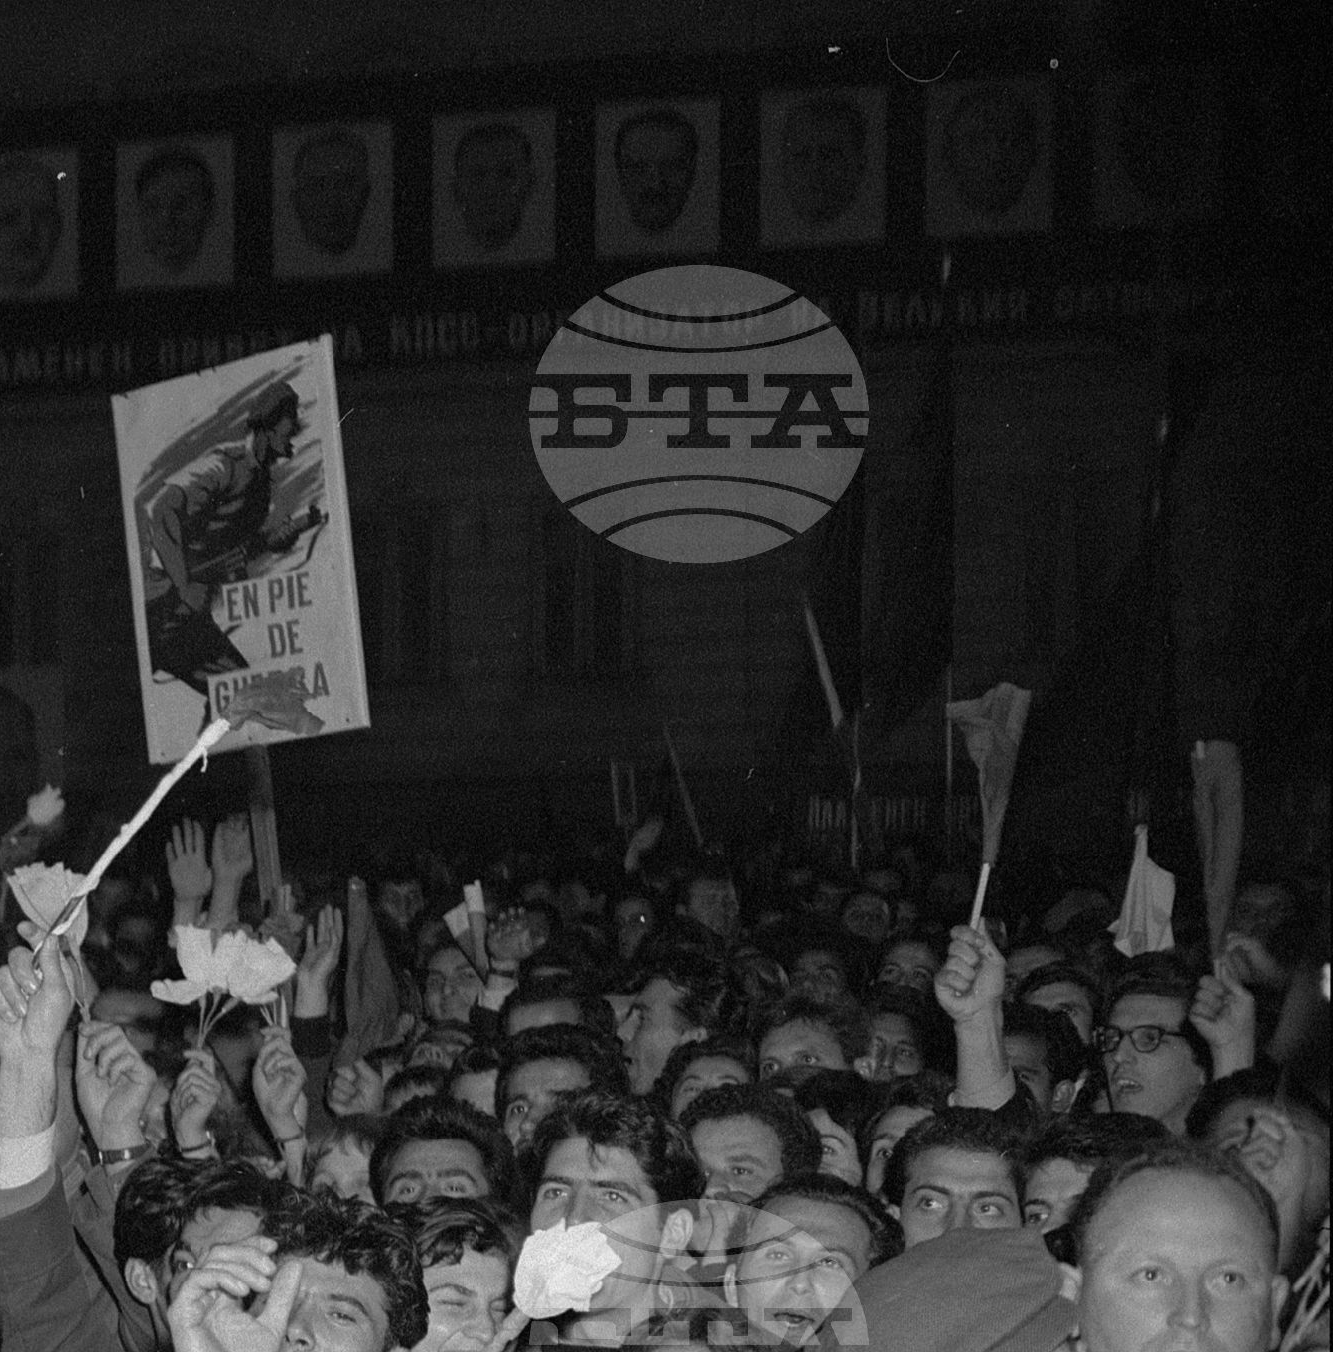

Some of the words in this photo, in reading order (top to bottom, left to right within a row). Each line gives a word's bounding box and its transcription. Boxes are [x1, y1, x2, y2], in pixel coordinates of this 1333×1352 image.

[226, 582, 260, 623] EN
[267, 571, 313, 614] PIE
[268, 619, 304, 659] DE
